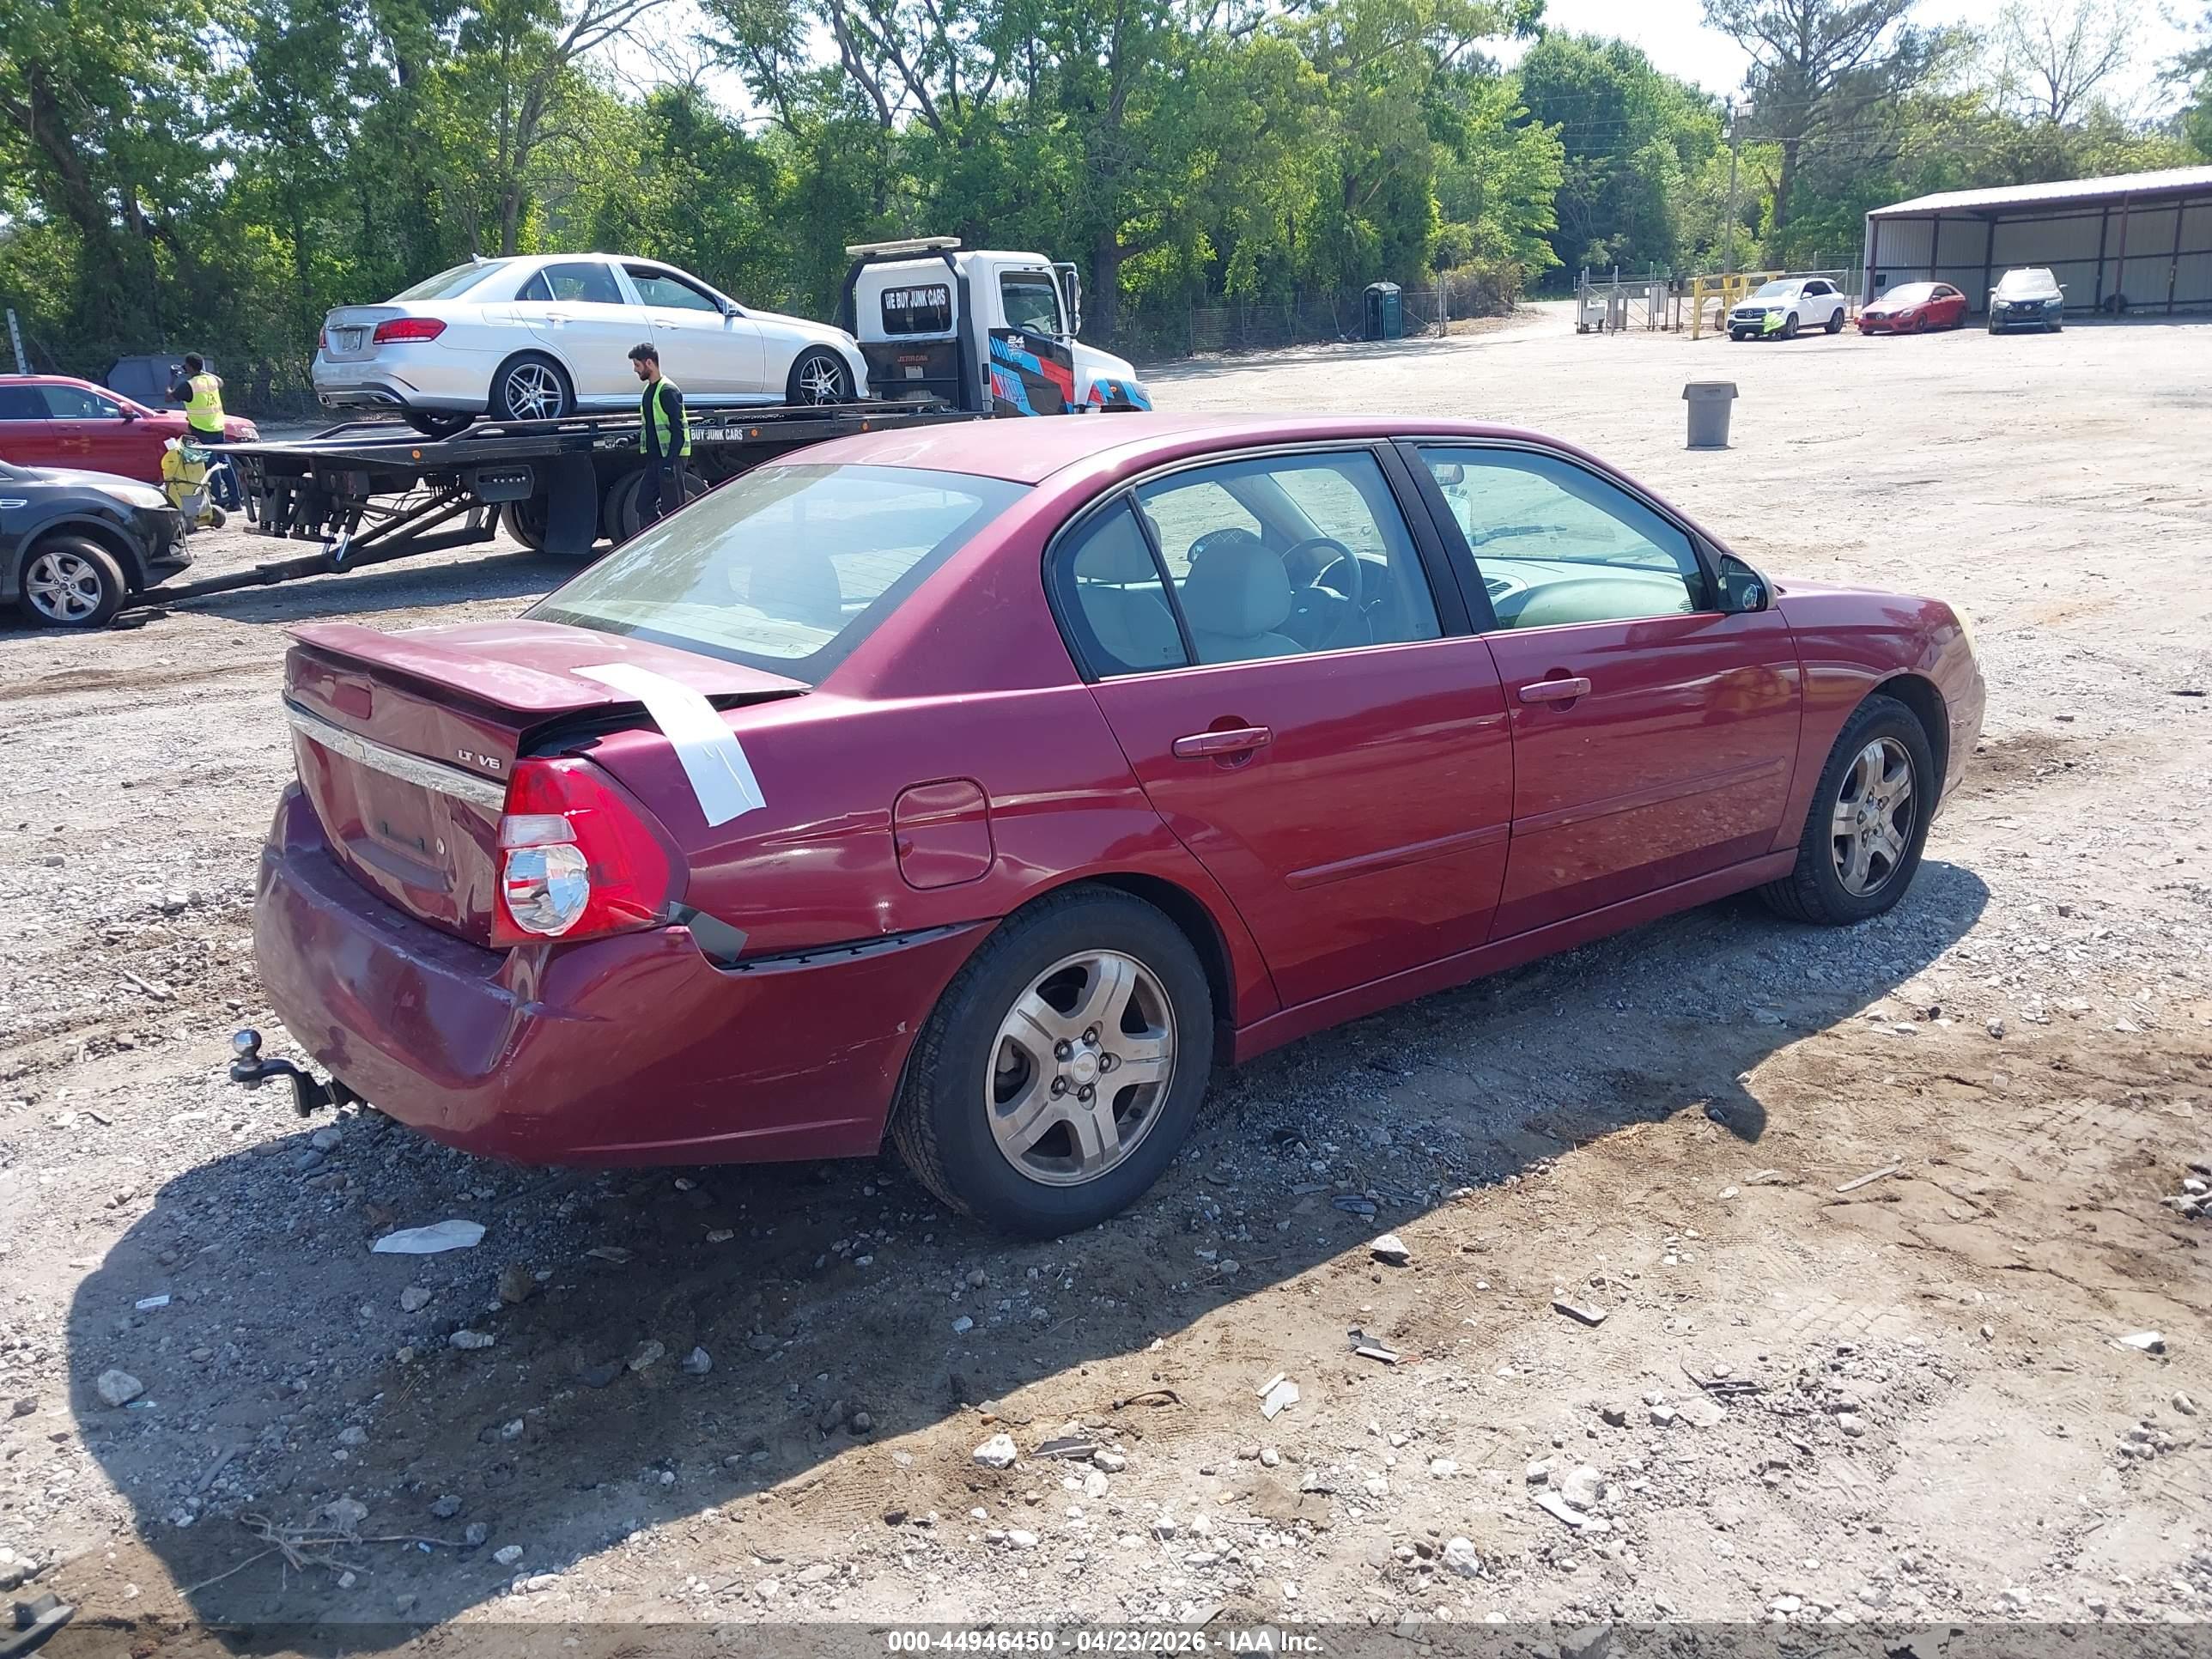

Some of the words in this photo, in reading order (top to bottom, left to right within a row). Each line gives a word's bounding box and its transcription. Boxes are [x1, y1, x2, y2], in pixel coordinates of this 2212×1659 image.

[884, 292, 896, 310] WE
[896, 291, 908, 309] BUY
[910, 289, 927, 308] JUNK
[927, 288, 946, 307] CARS
[1007, 335, 1024, 344] 24
[690, 428, 704, 441] BUY
[706, 428, 724, 441] JUNK
[725, 428, 744, 441] CARS
[458, 749, 473, 762] LT
[478, 755, 501, 769] V6
